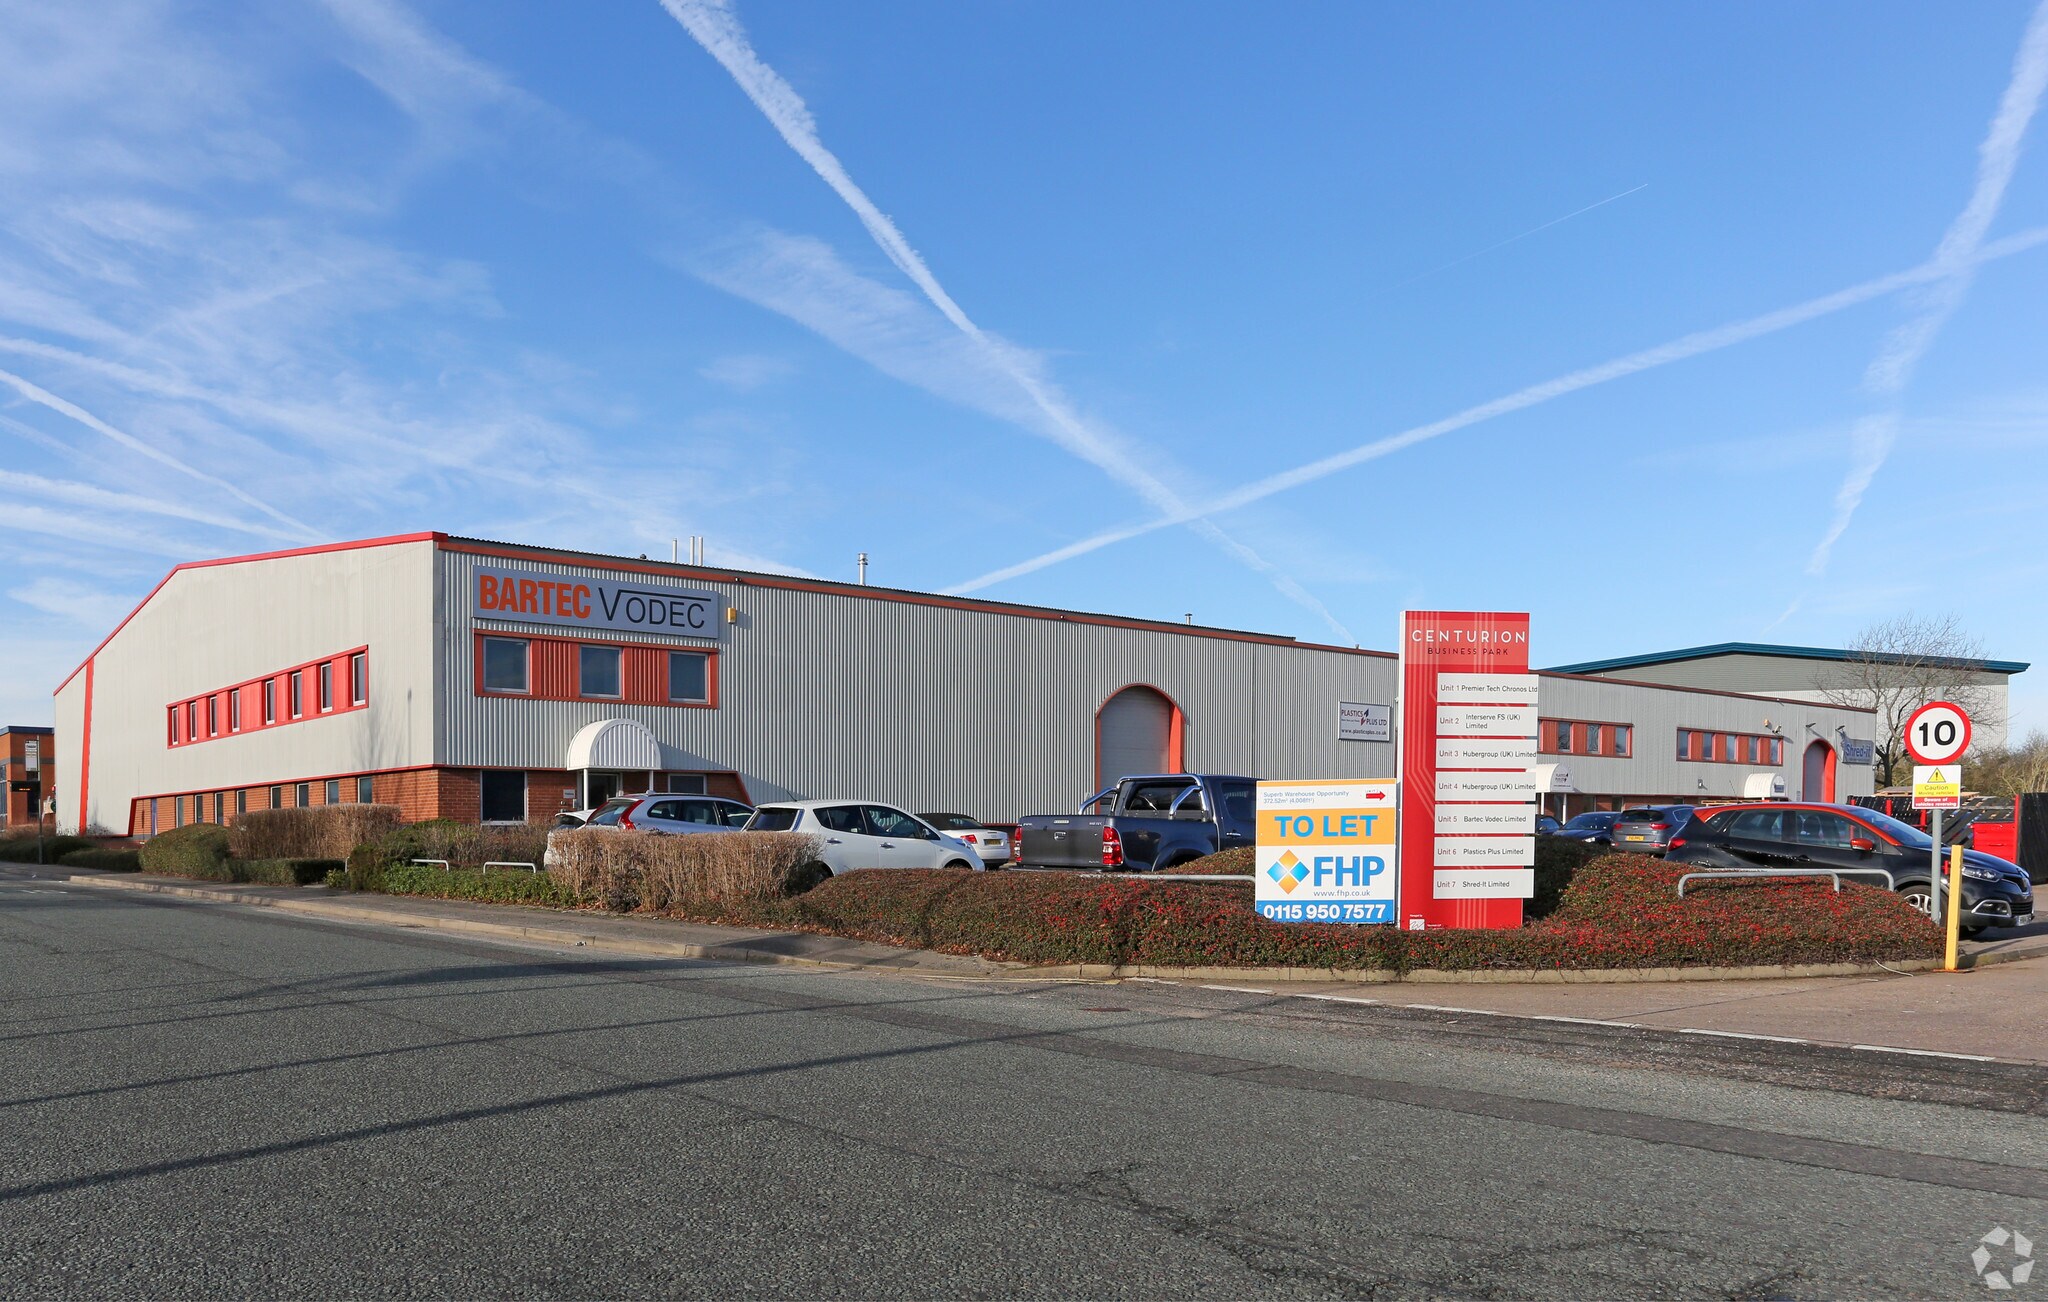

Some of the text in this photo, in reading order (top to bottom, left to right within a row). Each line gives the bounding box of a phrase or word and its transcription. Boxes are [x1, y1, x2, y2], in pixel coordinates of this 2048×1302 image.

[479, 574, 711, 630] BARTEC VODEC
[1412, 629, 1526, 643] CENTURION
[1427, 647, 1508, 656] BUSINESS PARK
[1502, 685, 1527, 693] Chronos
[1341, 709, 1363, 717] PLASTICS
[1919, 720, 1956, 747] 10
[1274, 815, 1378, 837] TO LET
[1313, 856, 1385, 886] FHP
[1313, 889, 1371, 897] www.fhp.co.uk
[1263, 904, 1386, 919] 0115 950 7577
